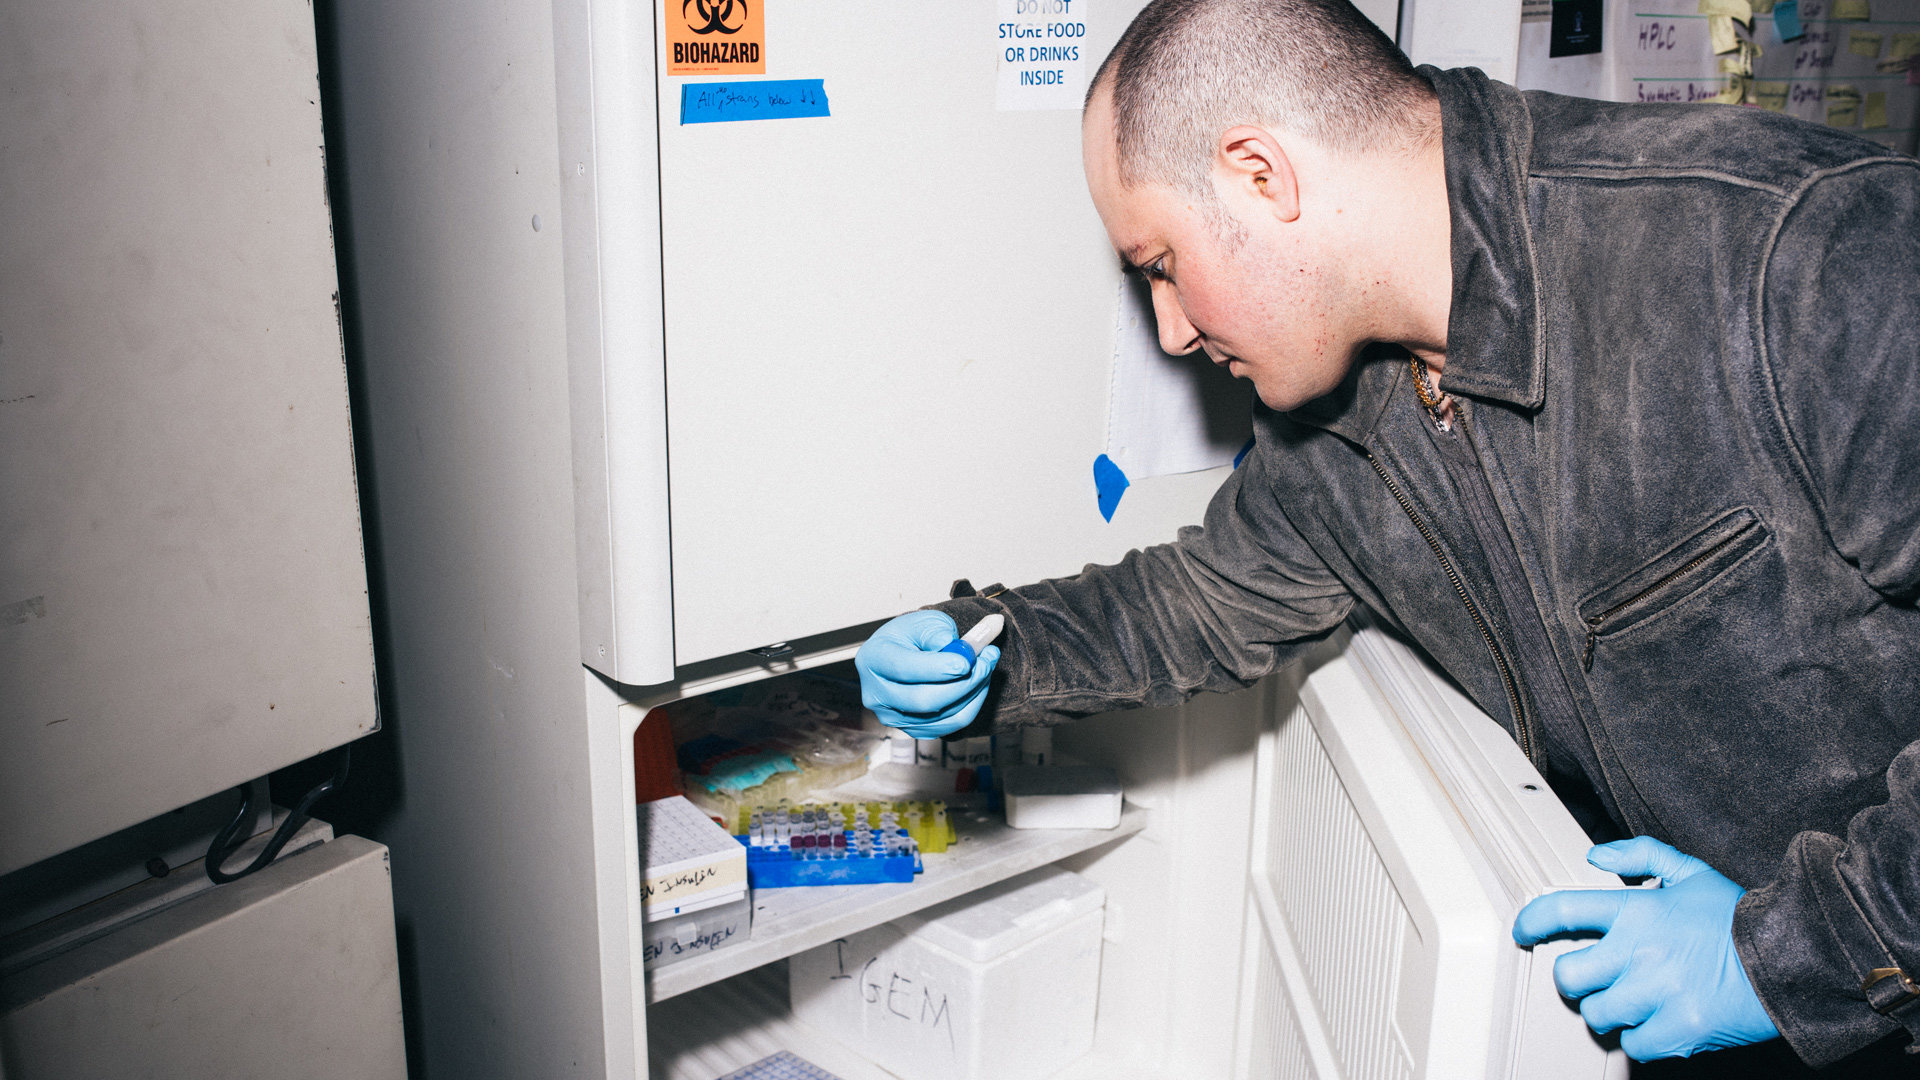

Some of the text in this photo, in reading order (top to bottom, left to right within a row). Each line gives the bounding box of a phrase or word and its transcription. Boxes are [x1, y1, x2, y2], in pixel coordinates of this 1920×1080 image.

[1017, 0, 1071, 14] DO NOT
[999, 23, 1085, 38] STORE FOOD
[1638, 22, 1676, 50] HPLC
[674, 42, 759, 64] BIOHAZARD
[1005, 46, 1079, 62] OR DRINKS
[1020, 70, 1064, 86] INSIDE
